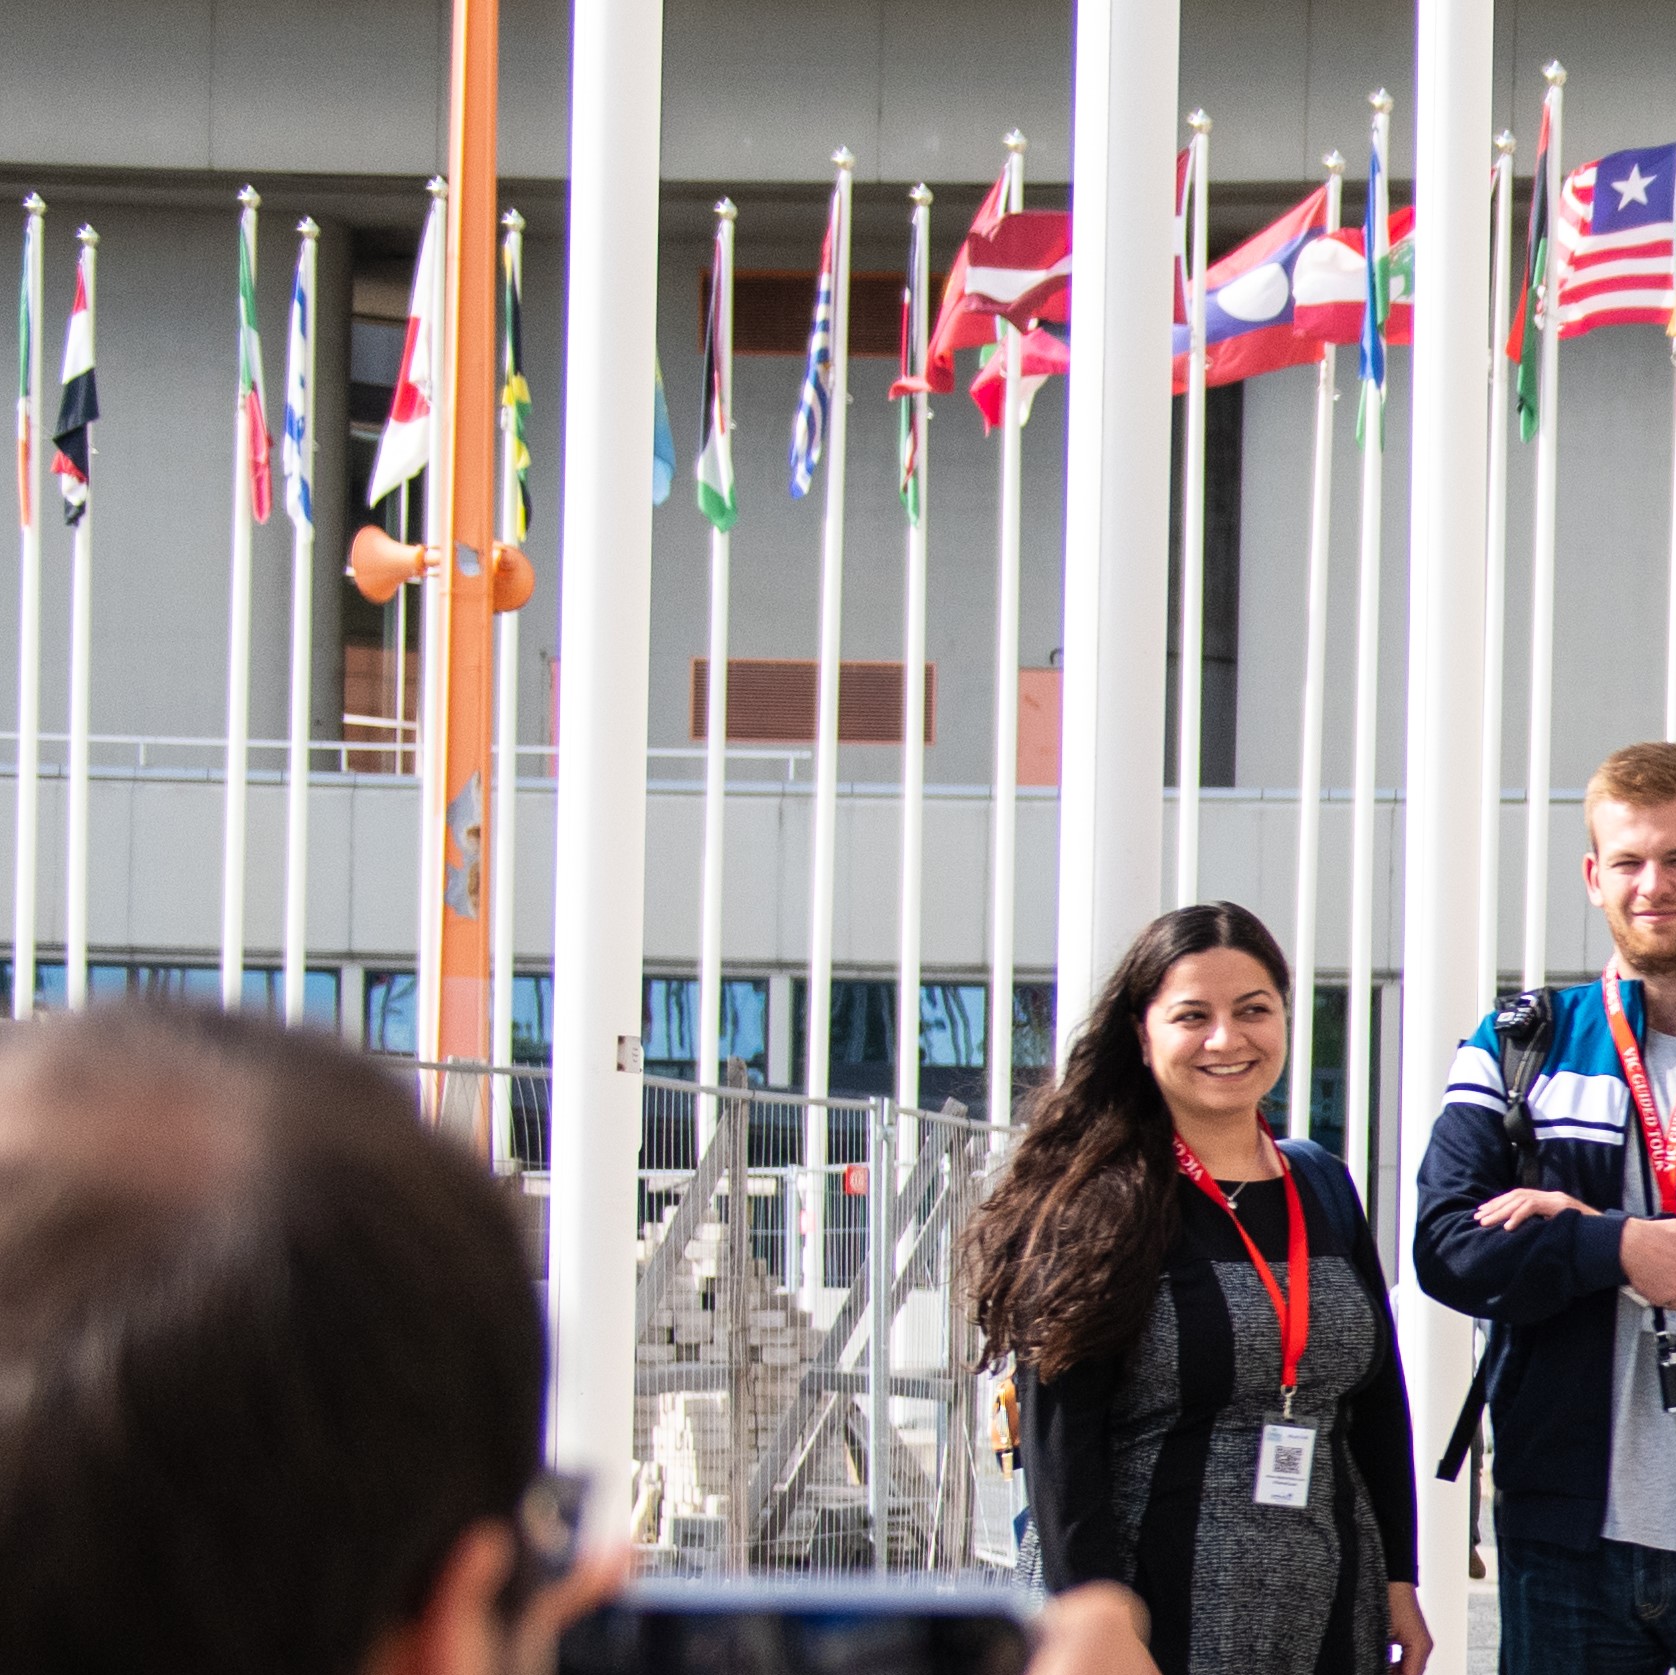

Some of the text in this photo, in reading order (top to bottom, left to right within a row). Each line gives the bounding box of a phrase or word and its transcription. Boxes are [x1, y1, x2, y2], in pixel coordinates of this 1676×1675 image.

[1623, 1046, 1643, 1073] VIC
[1631, 1073, 1659, 1127] GUIDED
[1180, 1153, 1204, 1181] VIC
